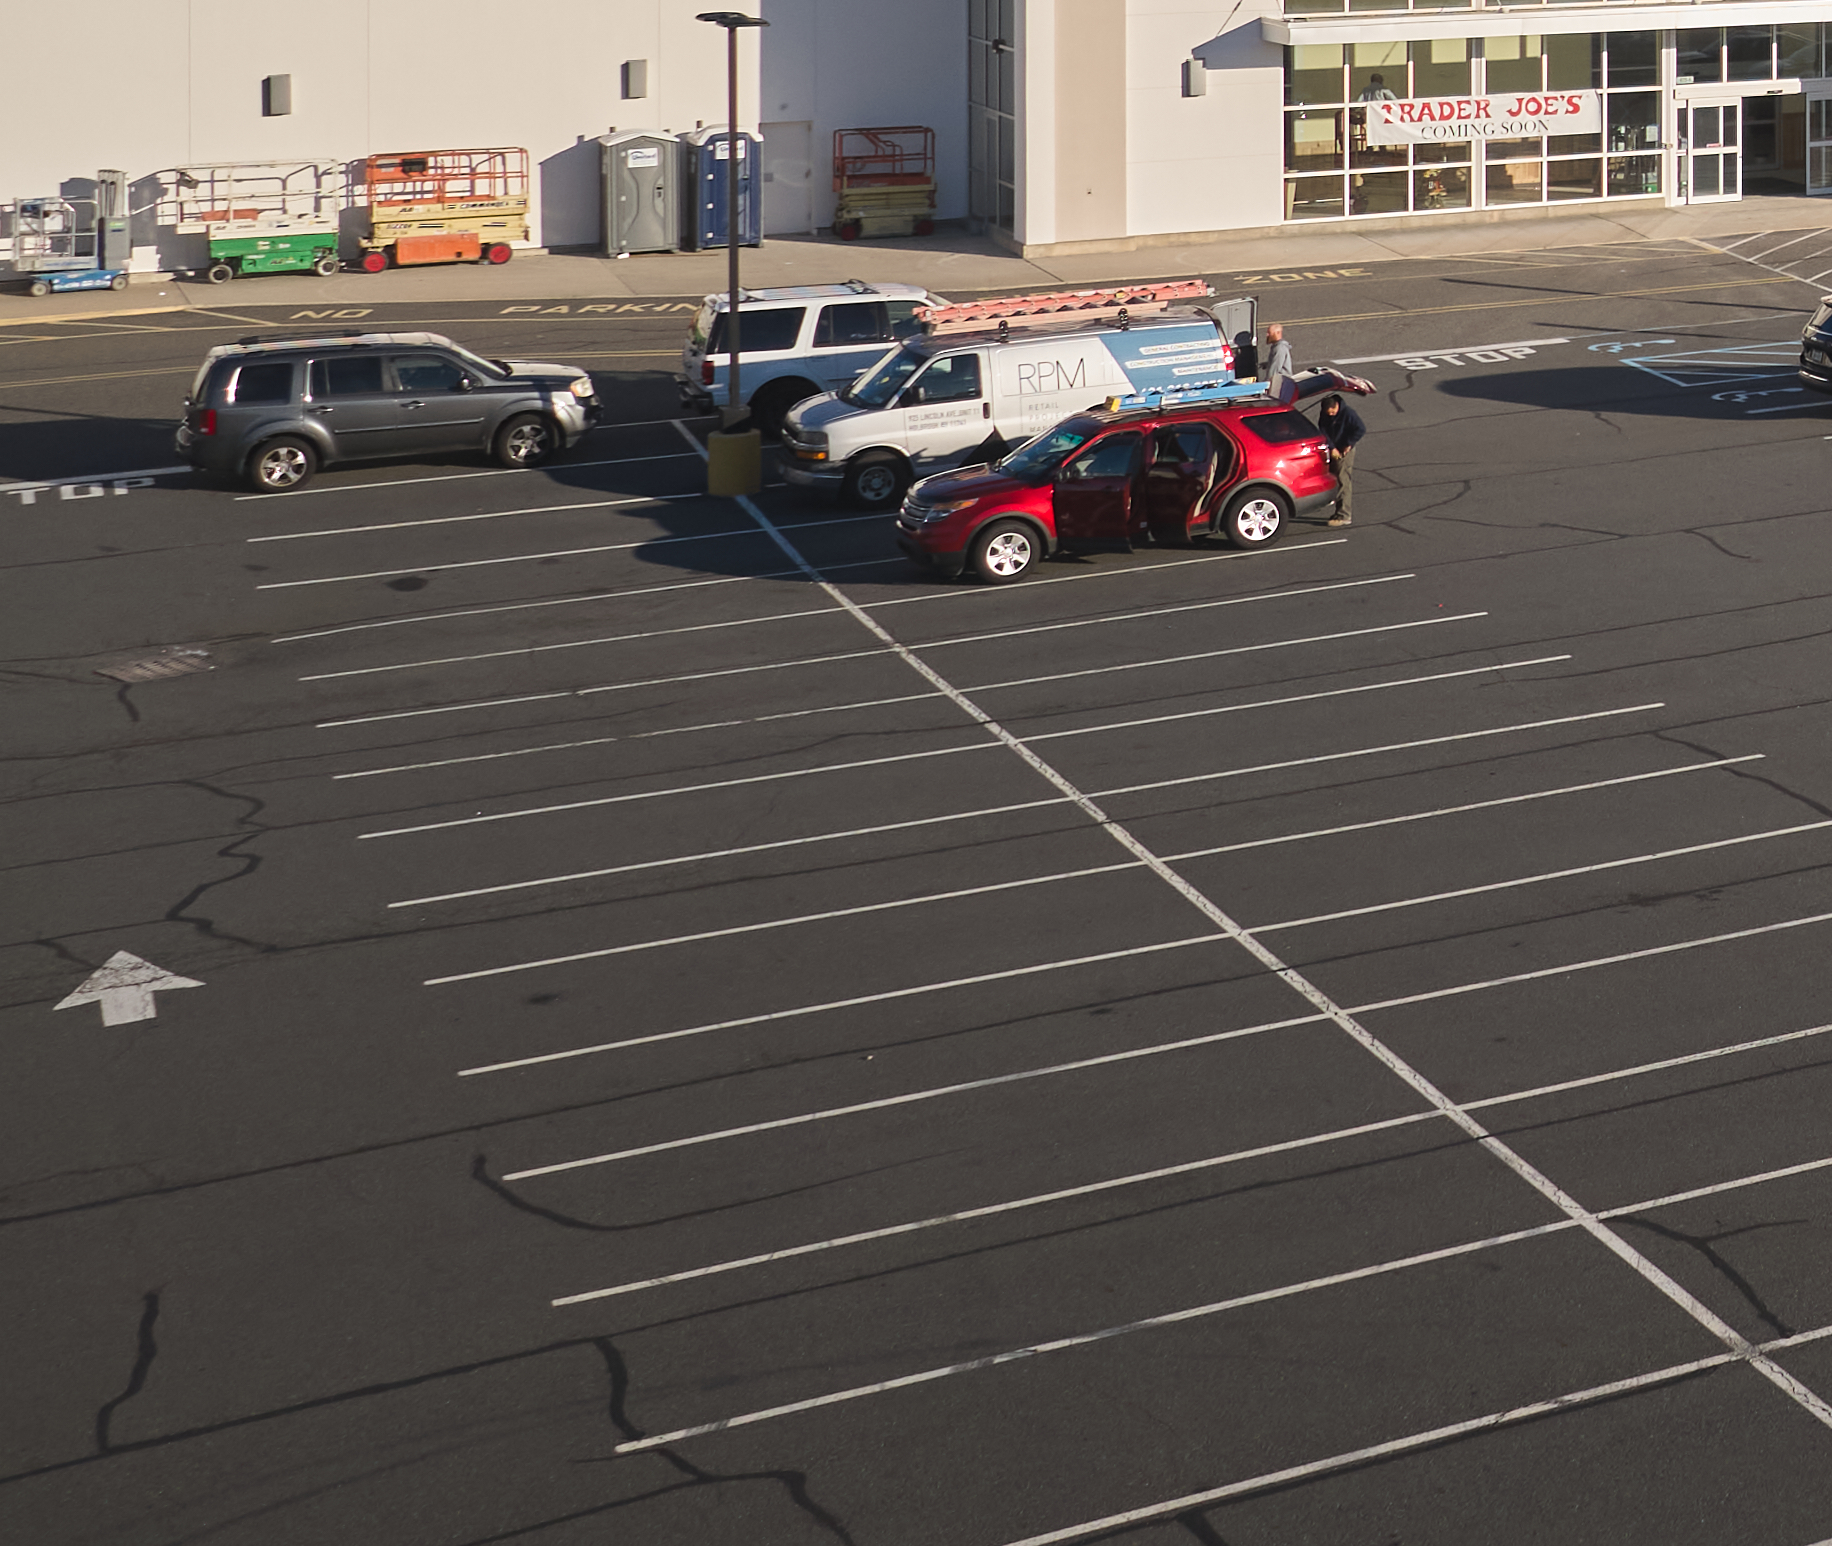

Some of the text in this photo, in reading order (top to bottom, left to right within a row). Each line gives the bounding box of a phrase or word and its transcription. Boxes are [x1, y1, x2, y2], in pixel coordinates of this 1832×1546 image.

[1380, 95, 1583, 124] TRADER JOE'S
[1421, 118, 1550, 140] COMING SOON
[1233, 268, 1373, 285] ZONE
[289, 302, 701, 319] NO PARKIN
[1393, 347, 1537, 370] STOP
[1017, 357, 1086, 396] RPM
[1028, 402, 1059, 411] RETAIL
[7, 477, 156, 505] TOP
